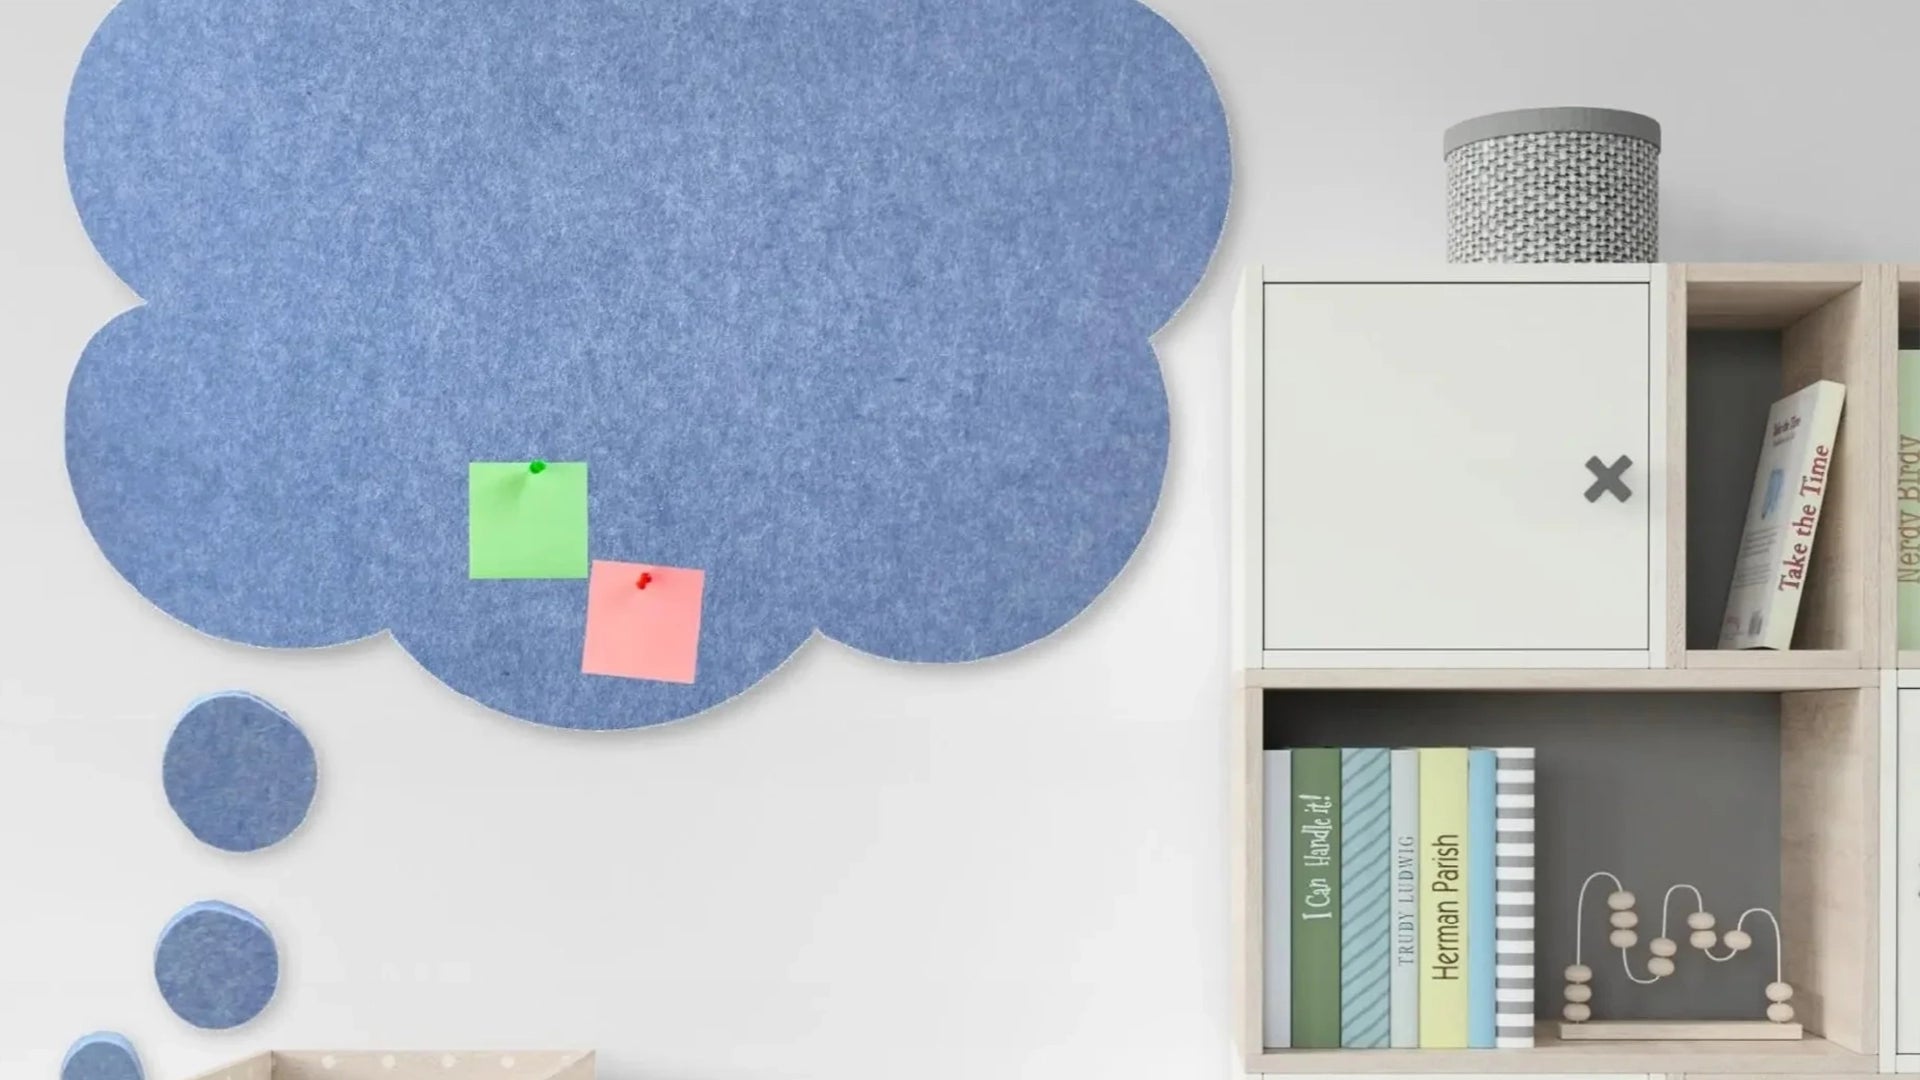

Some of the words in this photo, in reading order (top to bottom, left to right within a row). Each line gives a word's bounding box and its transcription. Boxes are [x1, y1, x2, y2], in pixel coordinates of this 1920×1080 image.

[1800, 444, 1830, 497] Time
[1898, 434, 1920, 503] Birdy
[1792, 504, 1817, 537] the
[1898, 510, 1920, 583] Nerdy
[1778, 542, 1808, 592] Take
[1298, 794, 1333, 814] it!
[1301, 817, 1333, 866] Handle
[1432, 834, 1459, 892] Parish
[1305, 877, 1332, 908] Can
[1398, 836, 1414, 903] LUDWIG
[1302, 912, 1332, 921] I
[1398, 913, 1414, 967] TRUDY
[1432, 901, 1459, 980] Herman
